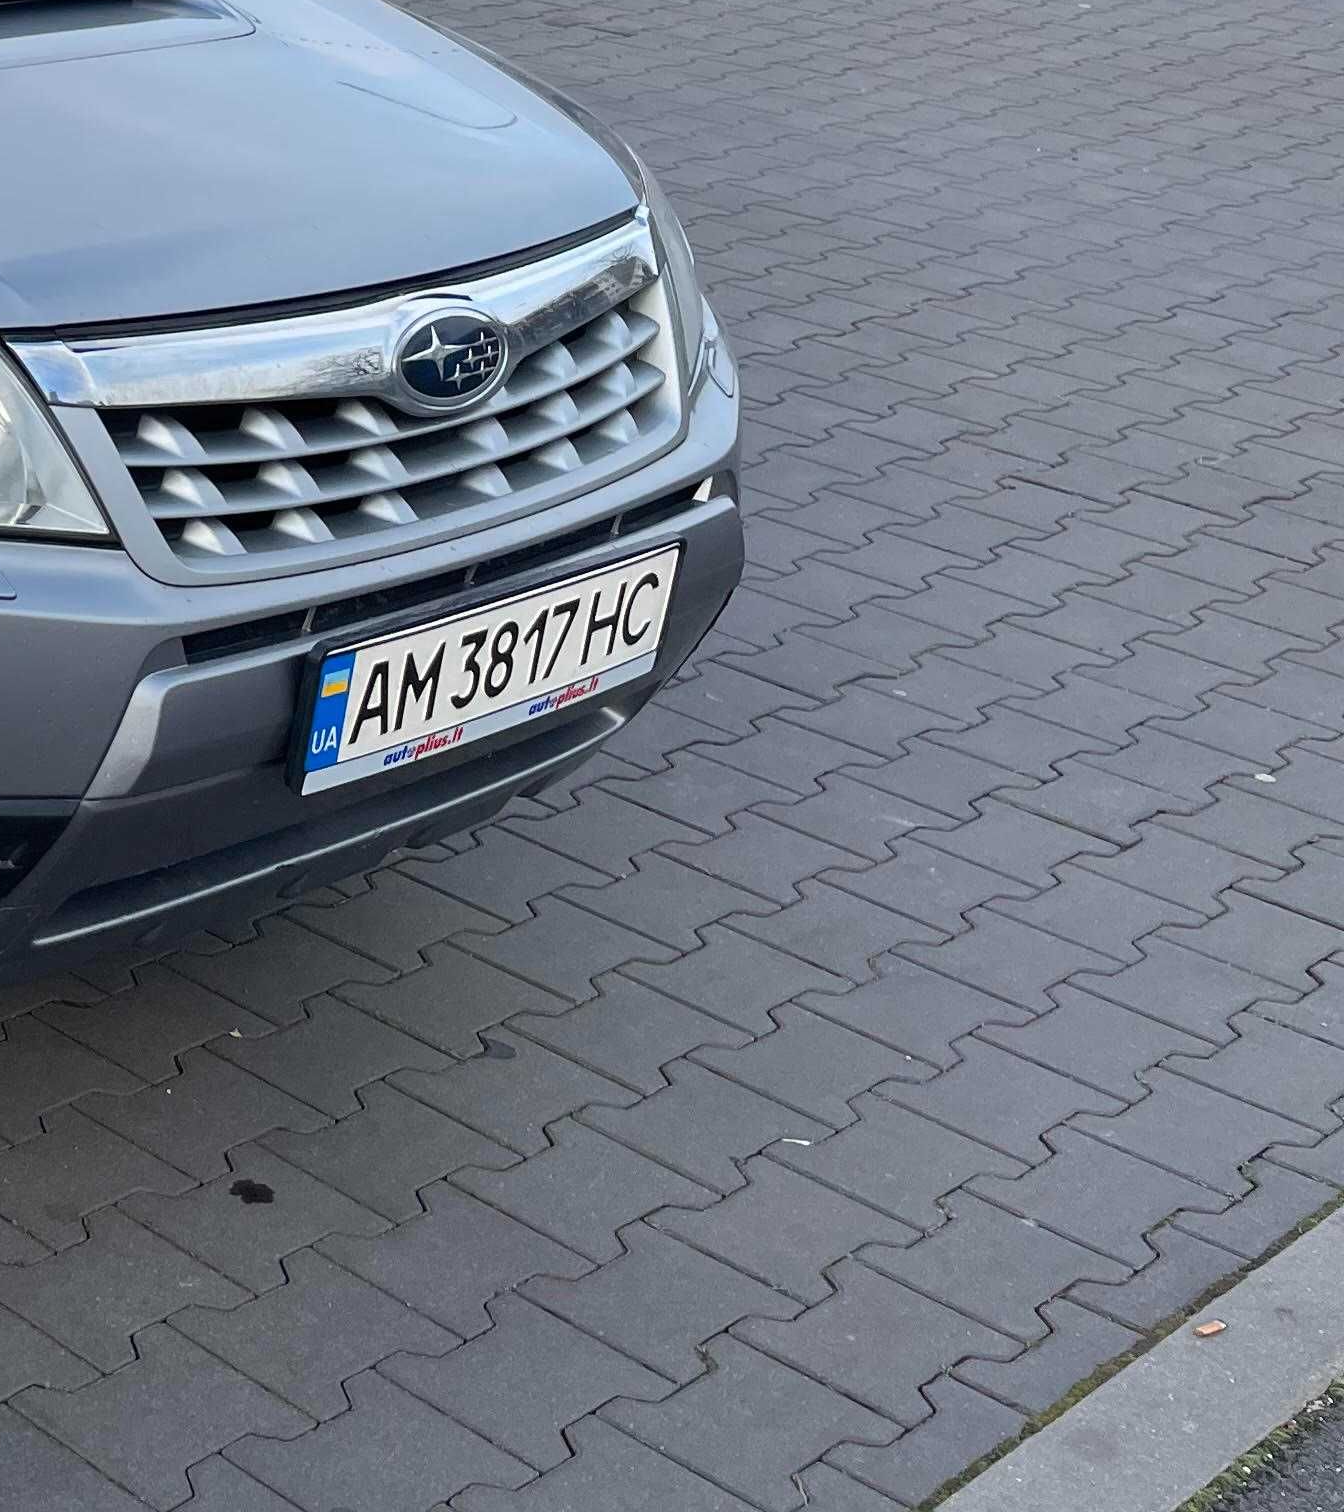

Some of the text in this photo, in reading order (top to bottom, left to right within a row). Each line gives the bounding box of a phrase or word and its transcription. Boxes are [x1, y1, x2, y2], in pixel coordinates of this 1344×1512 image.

[348, 572, 659, 745] AM 3817 HC
[312, 726, 337, 754] UA
[383, 727, 463, 766] autoplius.lt
